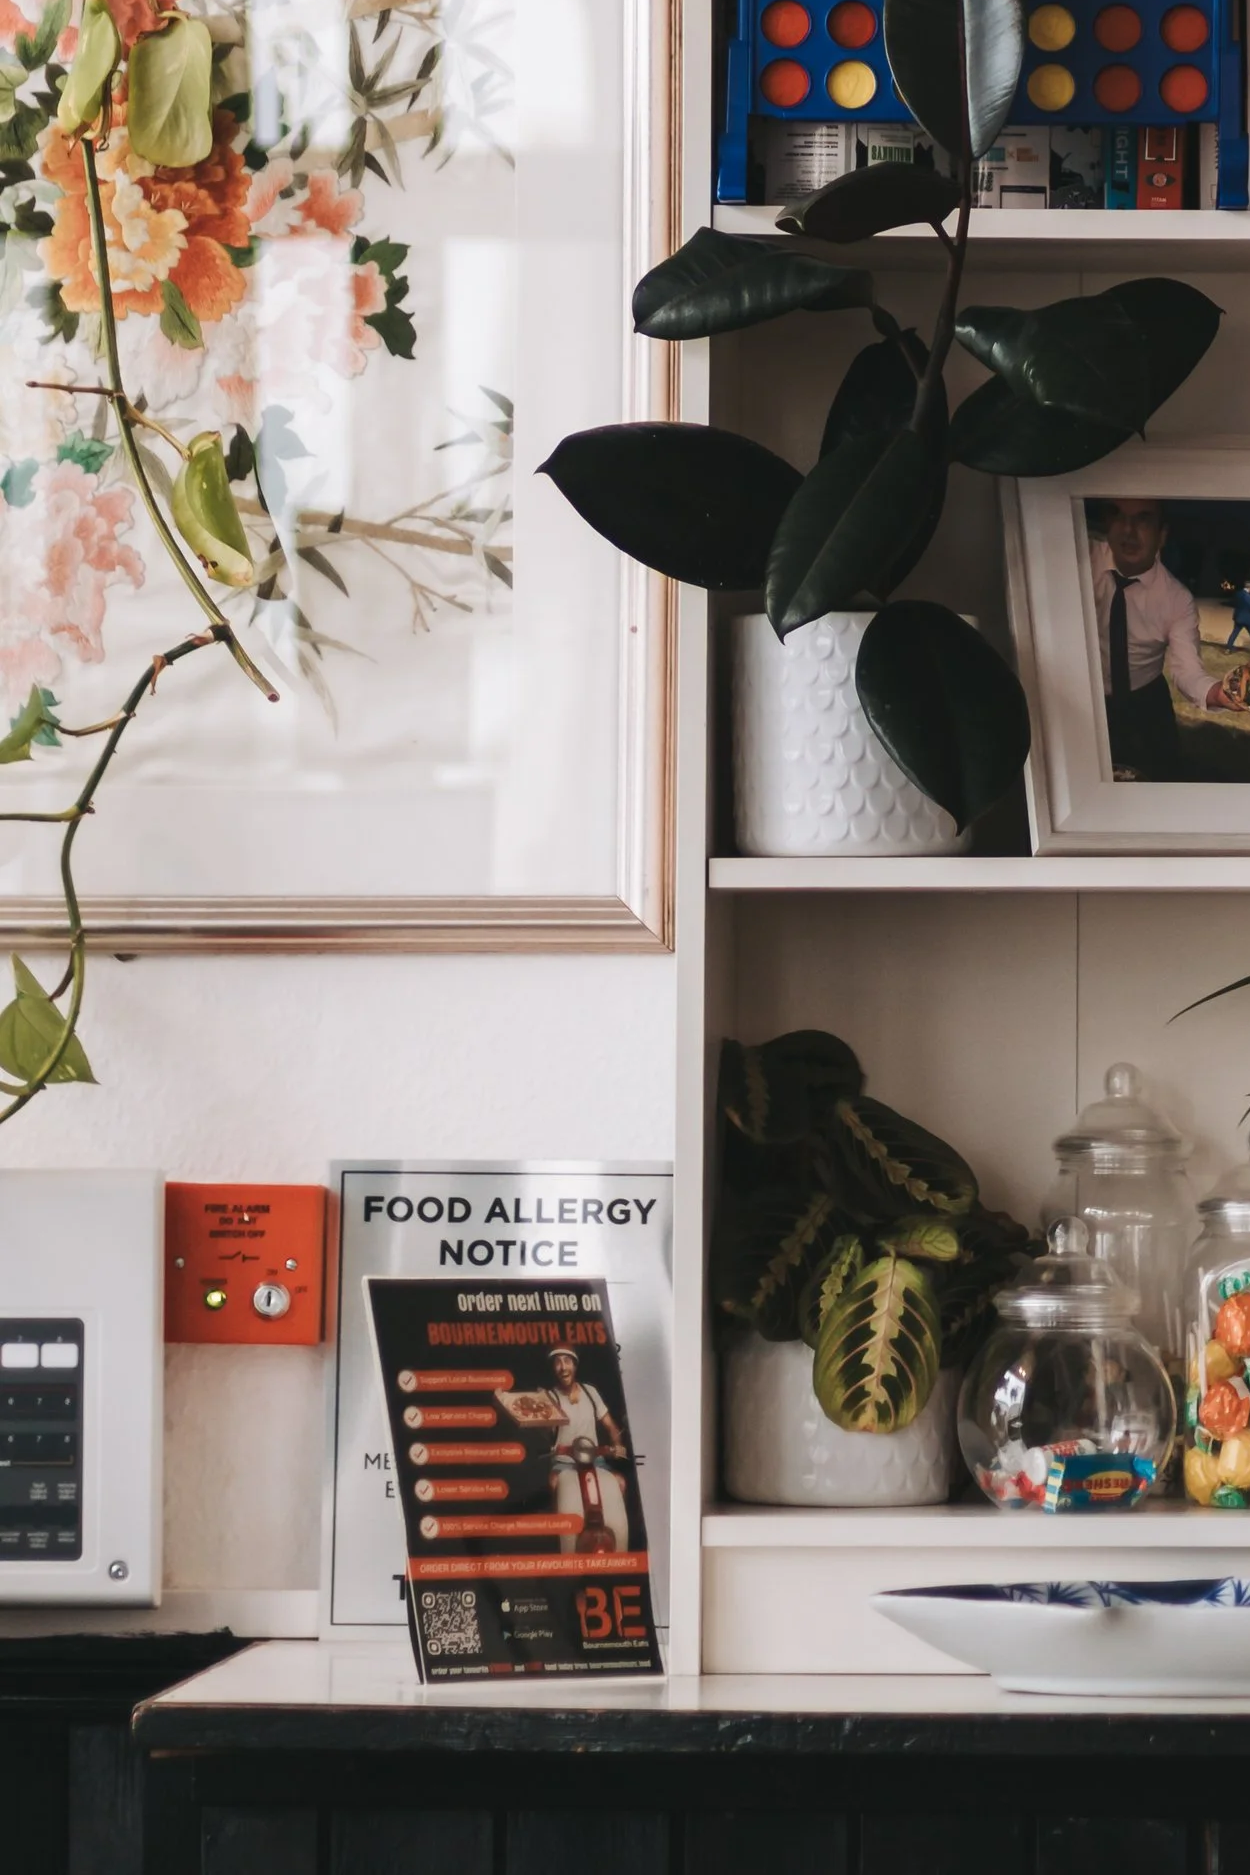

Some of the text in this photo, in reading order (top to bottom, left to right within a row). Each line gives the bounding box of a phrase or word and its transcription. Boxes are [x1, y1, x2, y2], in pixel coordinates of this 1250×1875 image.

[232, 1204, 271, 1214] ALARM
[363, 1195, 657, 1224] FOOD ALLERGY
[439, 1239, 578, 1267] NOTICE
[508, 1291, 541, 1312] next
[545, 1291, 579, 1312] time
[582, 1293, 602, 1312] on
[427, 1321, 607, 1346] BOURNEMOUTH EATS
[449, 1375, 467, 1384] Local
[441, 1411, 466, 1421] Service
[468, 1411, 493, 1422] Charge
[459, 1485, 485, 1494] Service
[462, 1521, 488, 1531] Service
[490, 1520, 515, 1531] Charge
[420, 1557, 637, 1573] ORDER DIRECT FROM YOUR FAVOURITE TAKEAWAYS
[514, 1603, 549, 1613] App Store
[576, 1586, 647, 1638] BE
[583, 1640, 649, 1650] Bournemouth Eats
